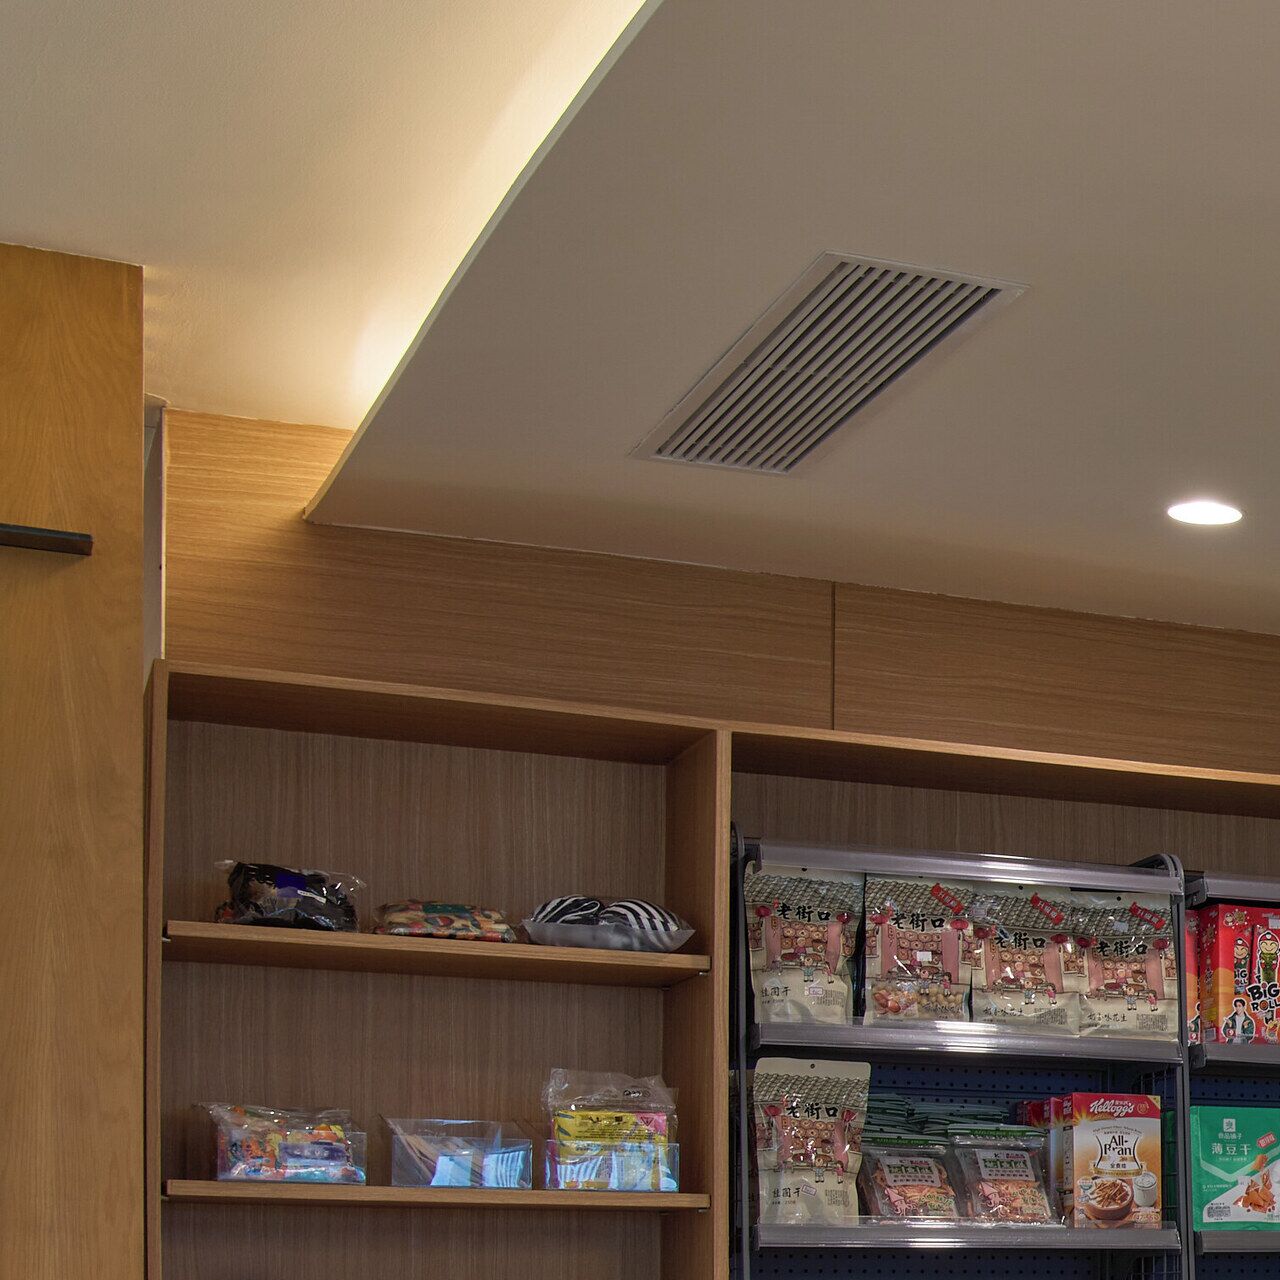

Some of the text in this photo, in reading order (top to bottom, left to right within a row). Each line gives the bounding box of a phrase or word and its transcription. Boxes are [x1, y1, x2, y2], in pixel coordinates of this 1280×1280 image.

[777, 902, 831, 922] 老街口
[890, 912, 945, 932] 老街口
[994, 932, 1046, 950] 老街口
[1097, 940, 1148, 958] 老街口
[1252, 1000, 1280, 1011] ROLL
[786, 1101, 839, 1119] 老街口
[1089, 1098, 1135, 1116] Kellogg's
[1211, 1143, 1251, 1155] 薄豆干
